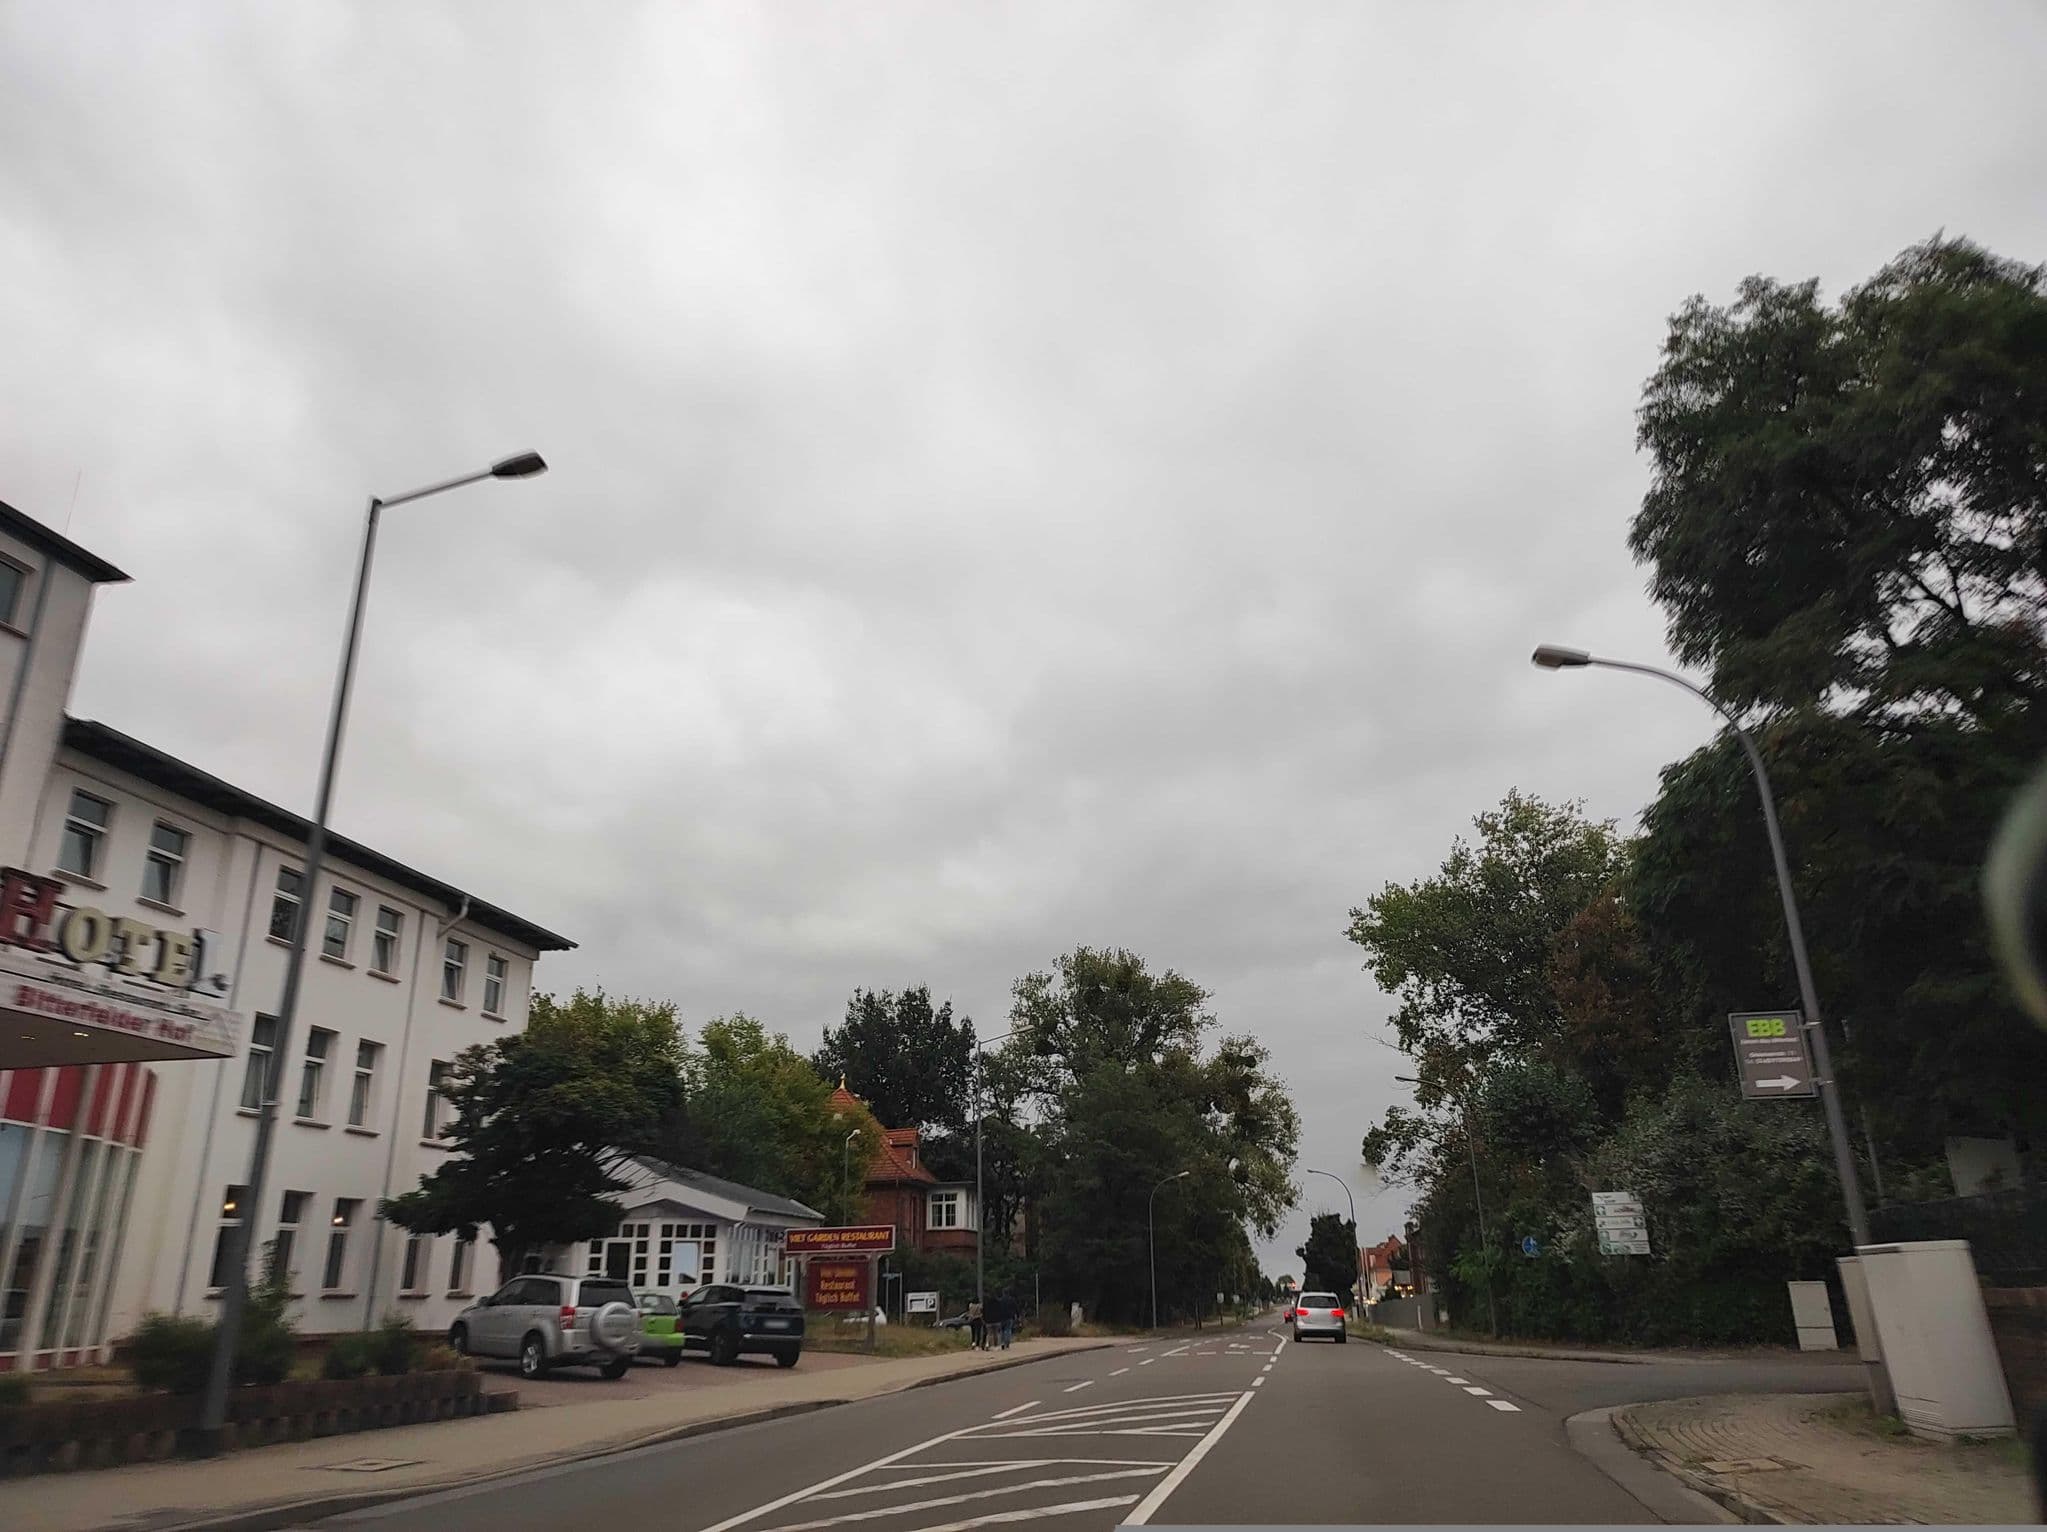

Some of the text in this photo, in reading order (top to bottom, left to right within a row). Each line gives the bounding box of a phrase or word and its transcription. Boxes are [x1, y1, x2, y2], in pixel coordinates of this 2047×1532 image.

[0, 867, 230, 997] HOTEL
[1745, 1018, 1785, 1037] EBB
[840, 1231, 890, 1241] RESTAURANT
